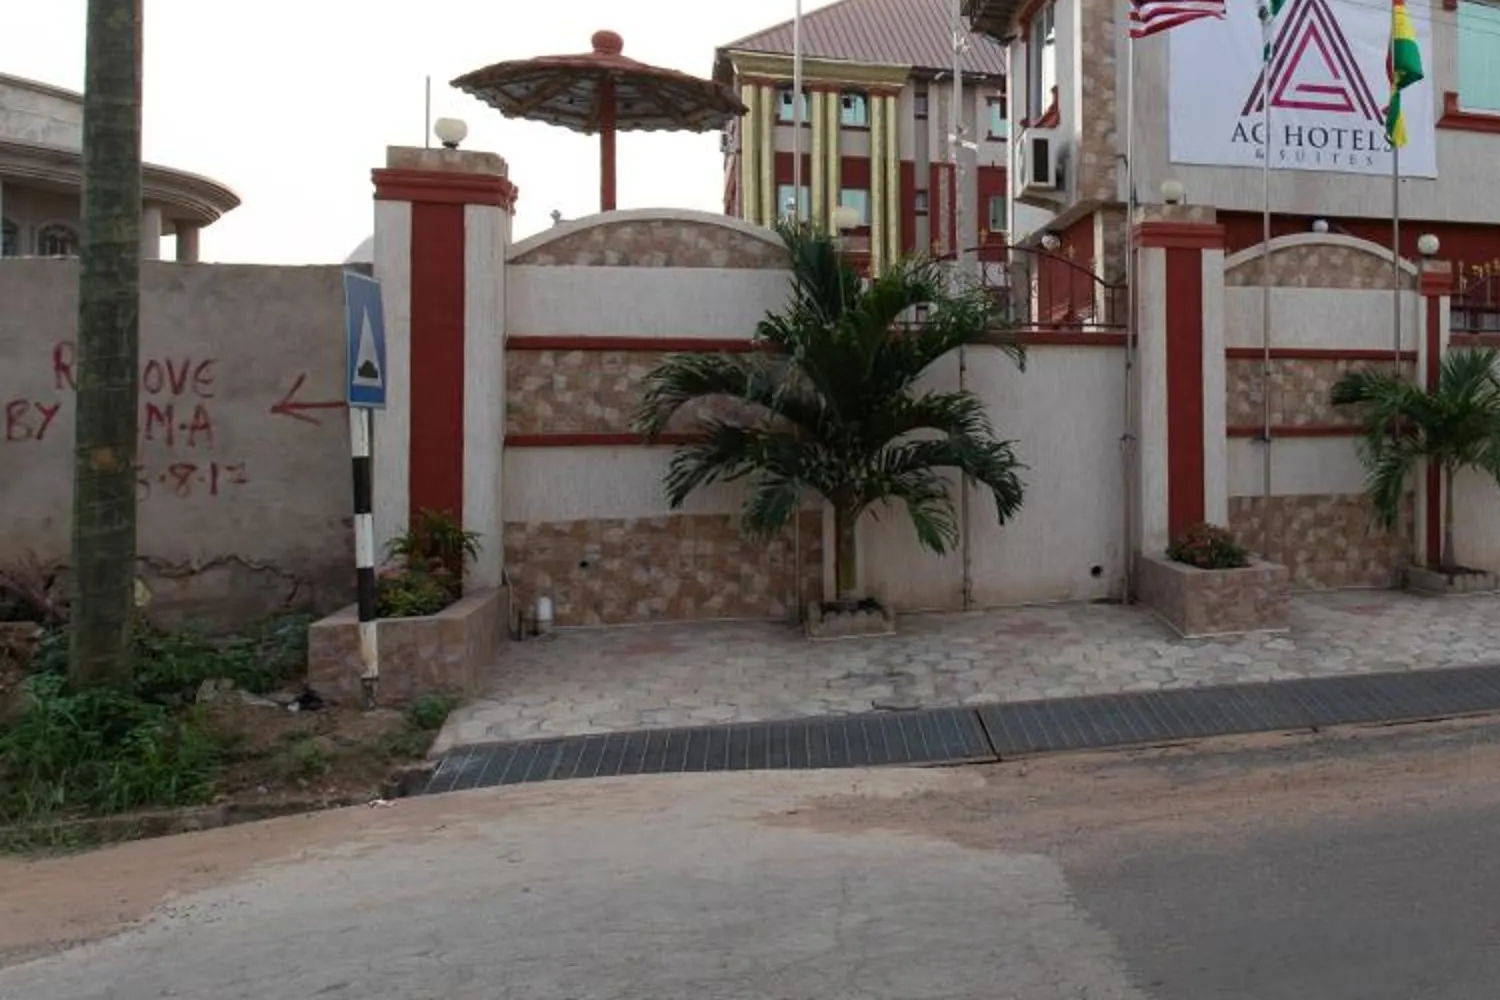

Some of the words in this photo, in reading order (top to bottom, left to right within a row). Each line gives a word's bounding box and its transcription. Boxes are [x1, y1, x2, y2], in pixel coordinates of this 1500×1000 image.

[1284, 124, 1394, 153] HOTELS
[1279, 149, 1373, 167] SUITES
[6, 399, 61, 441] BY
